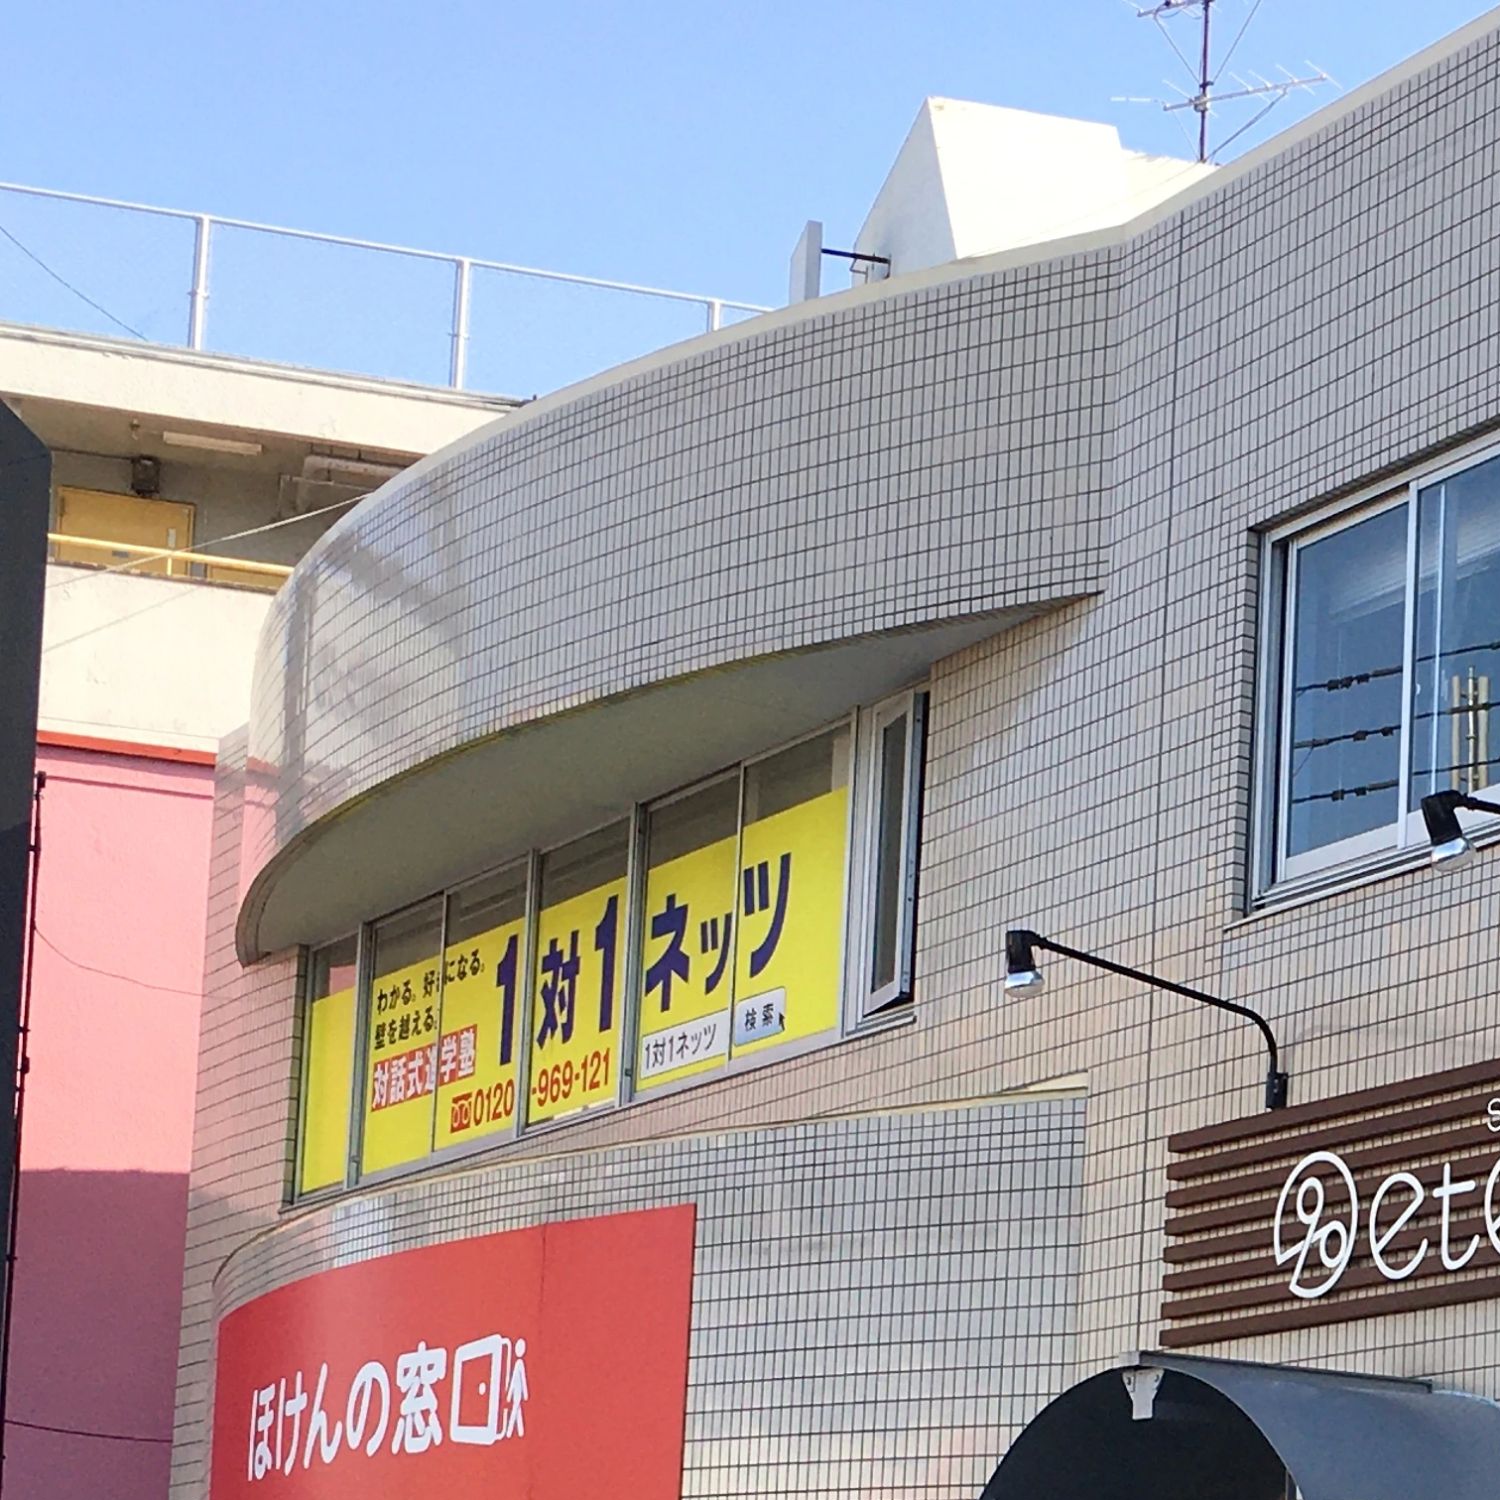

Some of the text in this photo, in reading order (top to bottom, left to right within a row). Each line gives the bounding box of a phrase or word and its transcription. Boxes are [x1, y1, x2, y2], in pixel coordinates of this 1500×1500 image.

[496, 852, 791, 1066] 1対1ネッツ
[644, 1022, 717, 1070] 1対1ネッツ
[744, 1003, 774, 1032] 検索
[248, 1333, 500, 1482] ほけんの窓口
